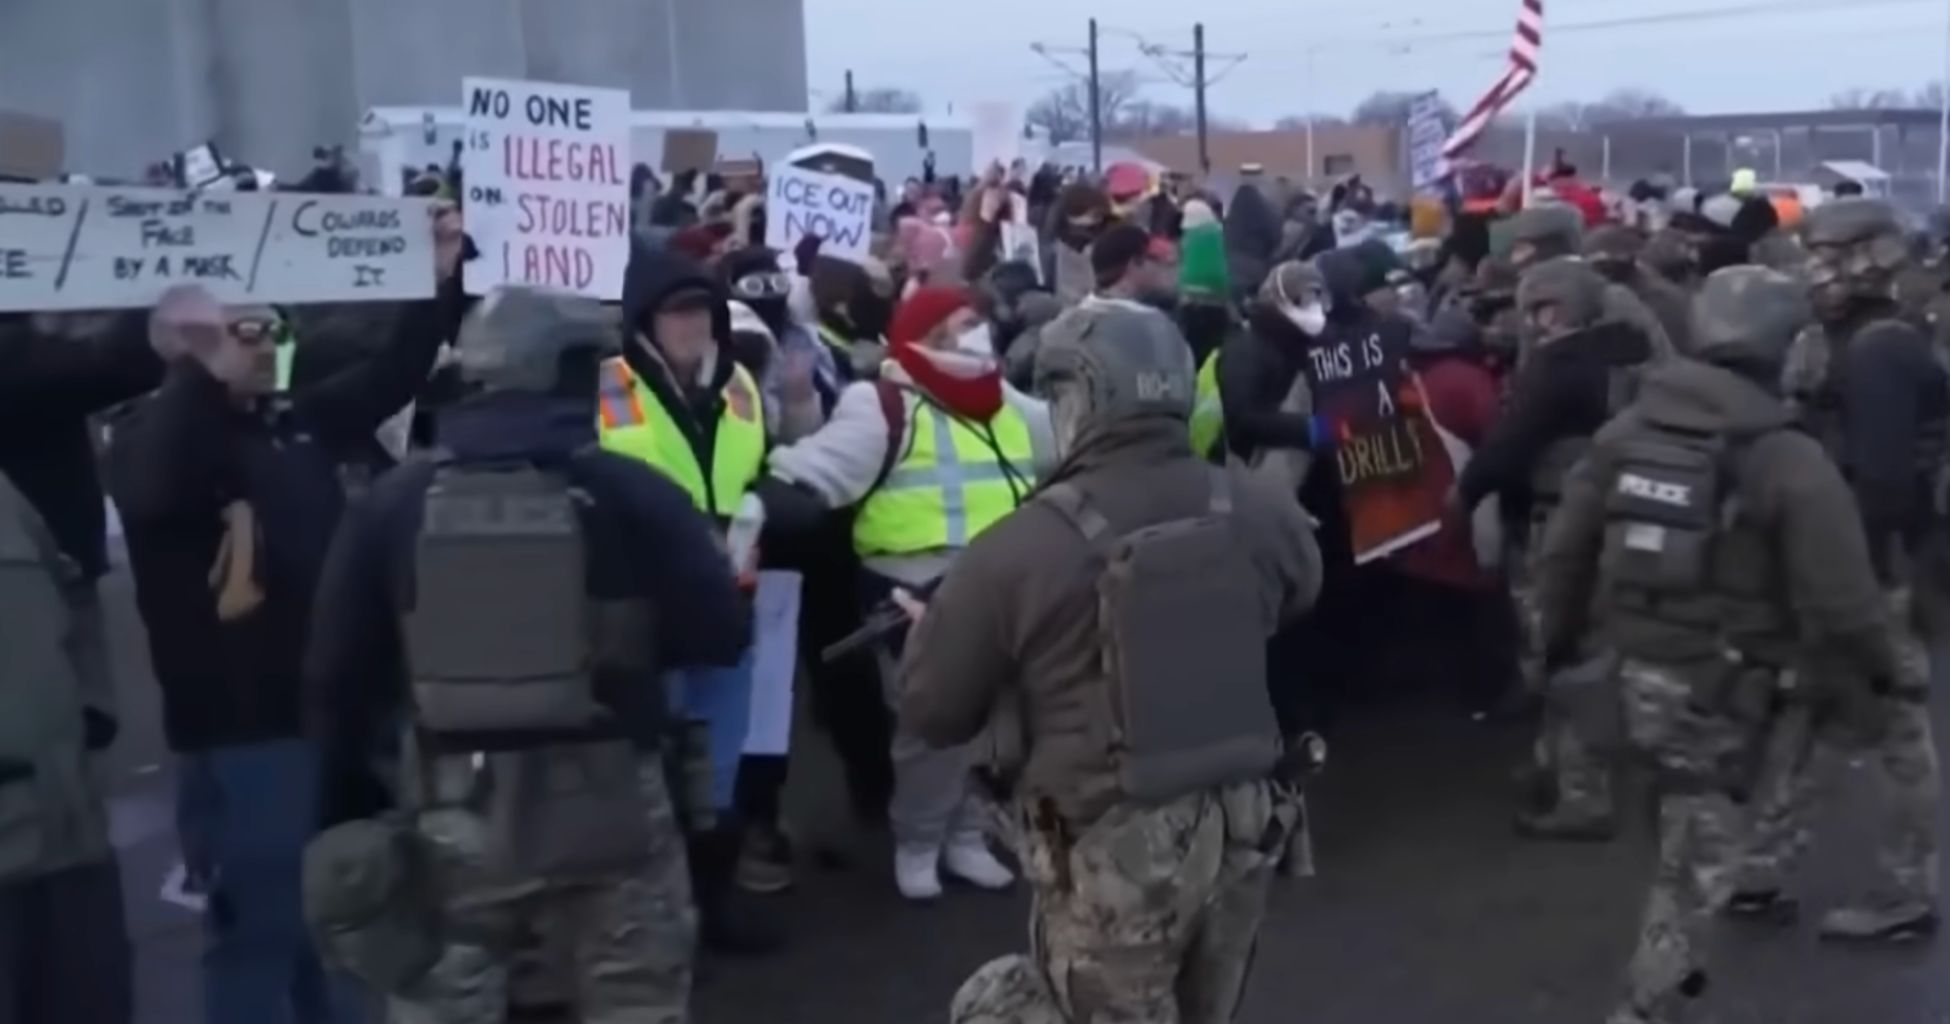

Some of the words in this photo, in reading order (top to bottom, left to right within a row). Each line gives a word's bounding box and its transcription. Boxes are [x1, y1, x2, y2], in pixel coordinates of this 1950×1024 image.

[470, 87, 510, 120] NO
[525, 94, 593, 131] ONE
[504, 133, 624, 185] ILLEGAL
[517, 192, 626, 238] STOLEN
[775, 175, 822, 208] ICE
[827, 186, 870, 217] OUT
[140, 218, 196, 249] FACE
[784, 209, 865, 248] NOW
[113, 256, 145, 281] BY
[154, 254, 170, 278] A
[352, 264, 386, 288] IT
[1308, 341, 1352, 382] THIS
[1362, 332, 1384, 370] IS
[1377, 378, 1395, 418] A
[1618, 472, 1693, 508] POLICE
